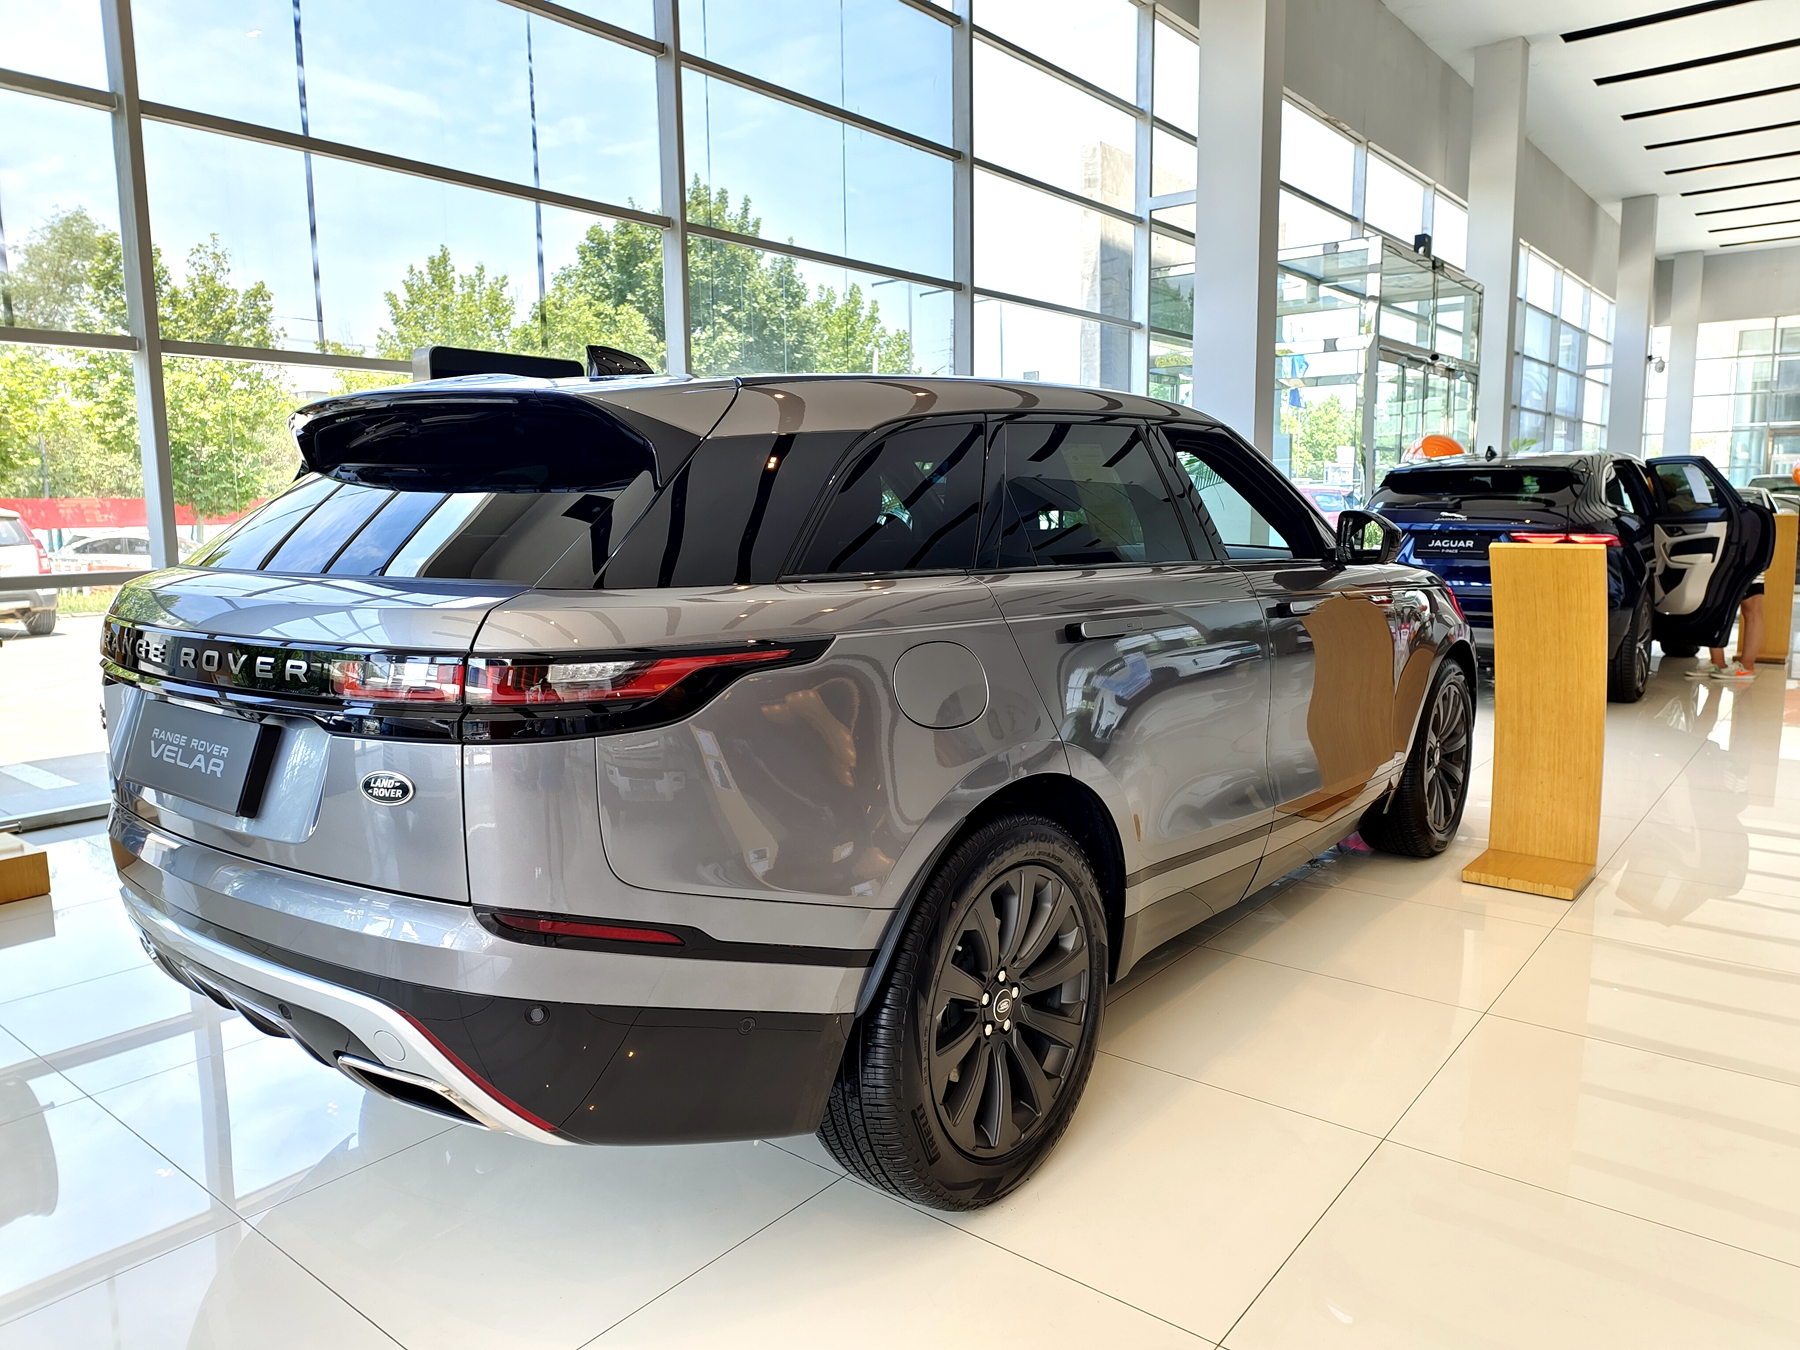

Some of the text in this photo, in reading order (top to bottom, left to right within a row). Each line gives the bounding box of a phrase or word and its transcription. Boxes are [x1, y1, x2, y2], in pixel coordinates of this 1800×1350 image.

[1428, 539, 1474, 548] JAGUAR
[104, 630, 308, 683] RANGE ROVER
[150, 739, 225, 778] VELAR
[151, 728, 229, 758] RANGE ROVER
[370, 777, 395, 788] LAND
[372, 787, 403, 798] ROVER
[1058, 840, 1089, 874] ZERO
[910, 1103, 942, 1167] PIRELLI
